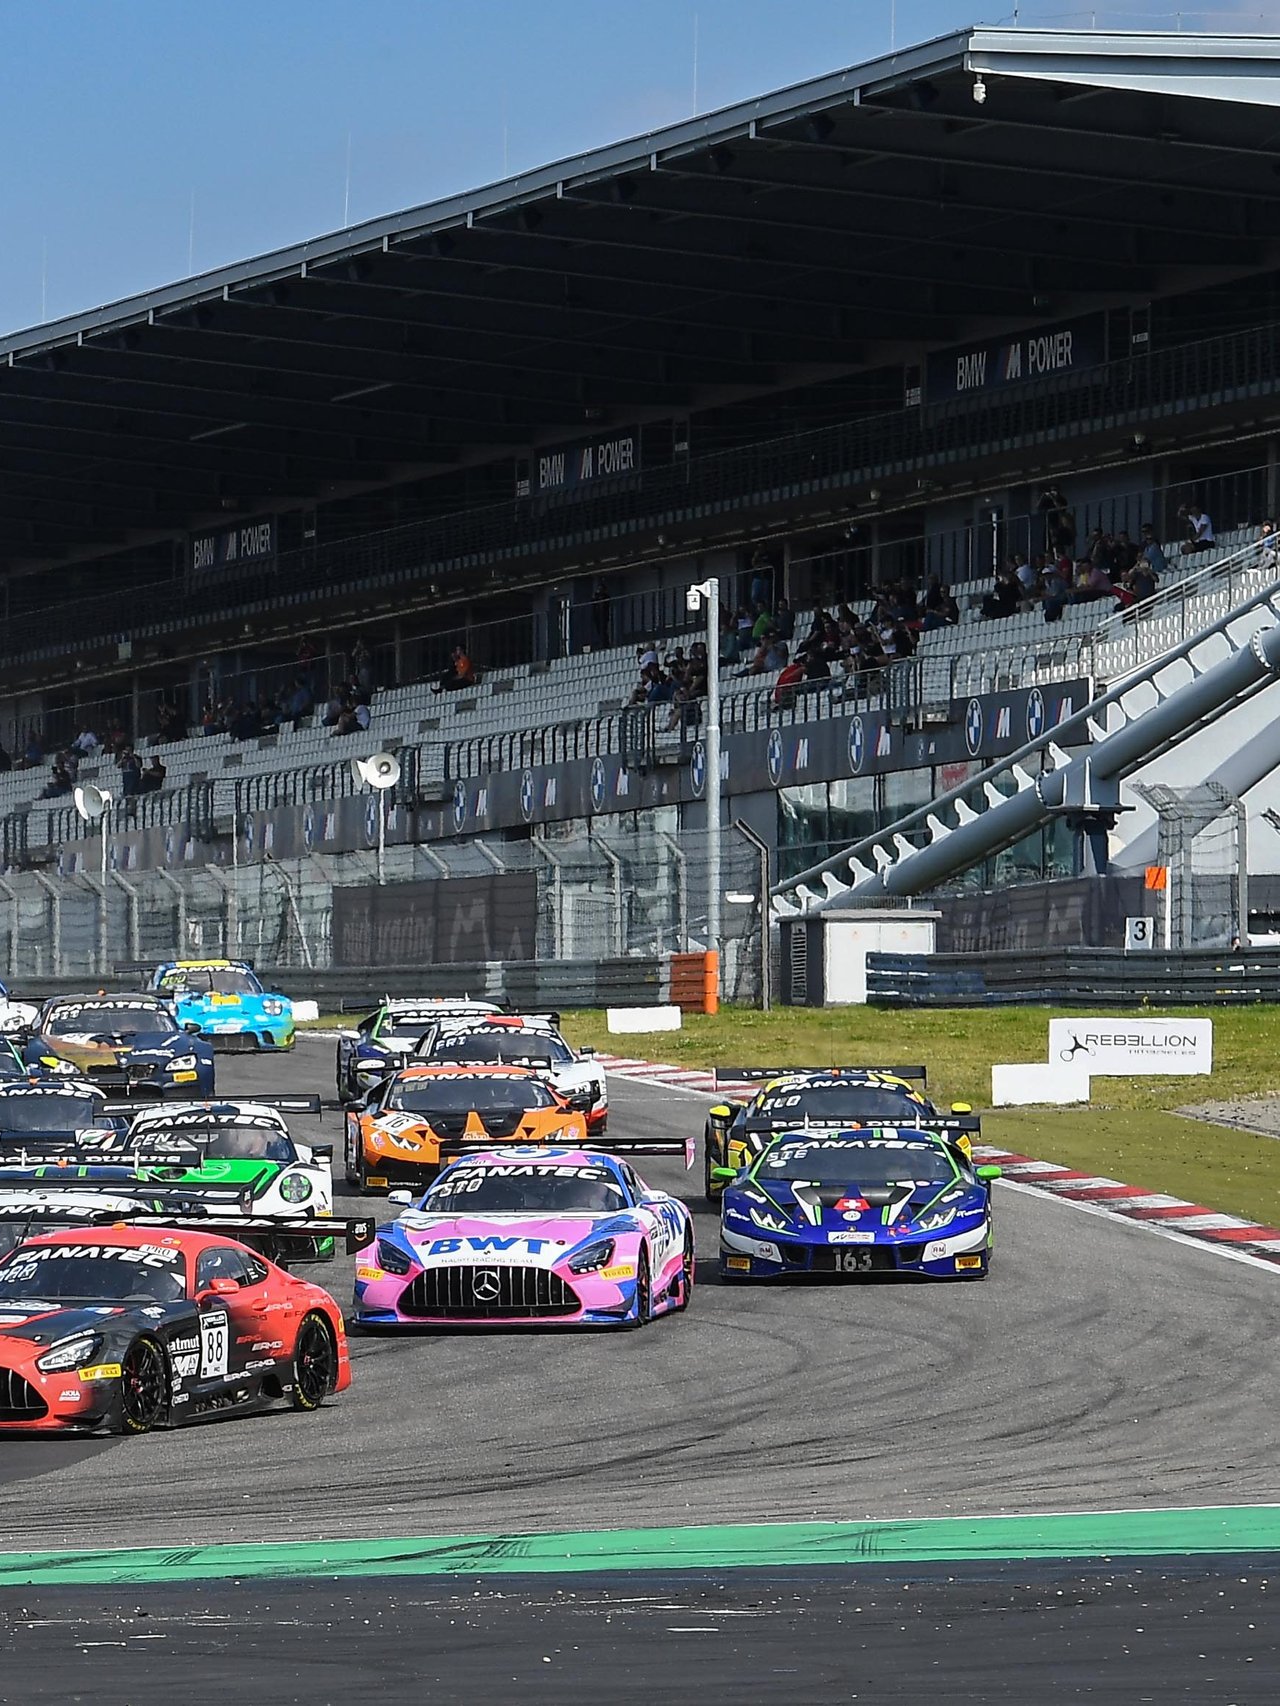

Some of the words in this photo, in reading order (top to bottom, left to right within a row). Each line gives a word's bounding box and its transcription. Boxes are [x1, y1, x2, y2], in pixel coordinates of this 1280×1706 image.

[957, 352, 986, 391] BMW
[1006, 343, 1021, 380] M
[1029, 331, 1072, 375] POWER
[540, 453, 564, 488] BMW
[581, 447, 593, 480] M
[598, 438, 634, 475] POWER
[194, 537, 214, 569] BMW
[241, 523, 271, 557] POWER
[996, 707, 1010, 738] M
[877, 725, 891, 757] M
[795, 738, 809, 769] M
[1133, 920, 1147, 941] 3
[443, 1026, 556, 1039] FANATEC
[436, 1036, 467, 1051] FRI
[402, 1073, 530, 1083] FANATEC
[780, 1080, 899, 1094] FANATEC
[137, 1115, 279, 1132] FANATEC
[772, 1120, 858, 1128] ROGER
[781, 1139, 933, 1151] FANATEC
[767, 1150, 808, 1162] SIE
[447, 1165, 607, 1182] FANATEC
[439, 1178, 483, 1197] STO
[428, 1237, 549, 1256] BWT
[9, 1246, 178, 1268] FANATEC
[833, 1247, 872, 1271] 163
[207, 1330, 223, 1364] 88
